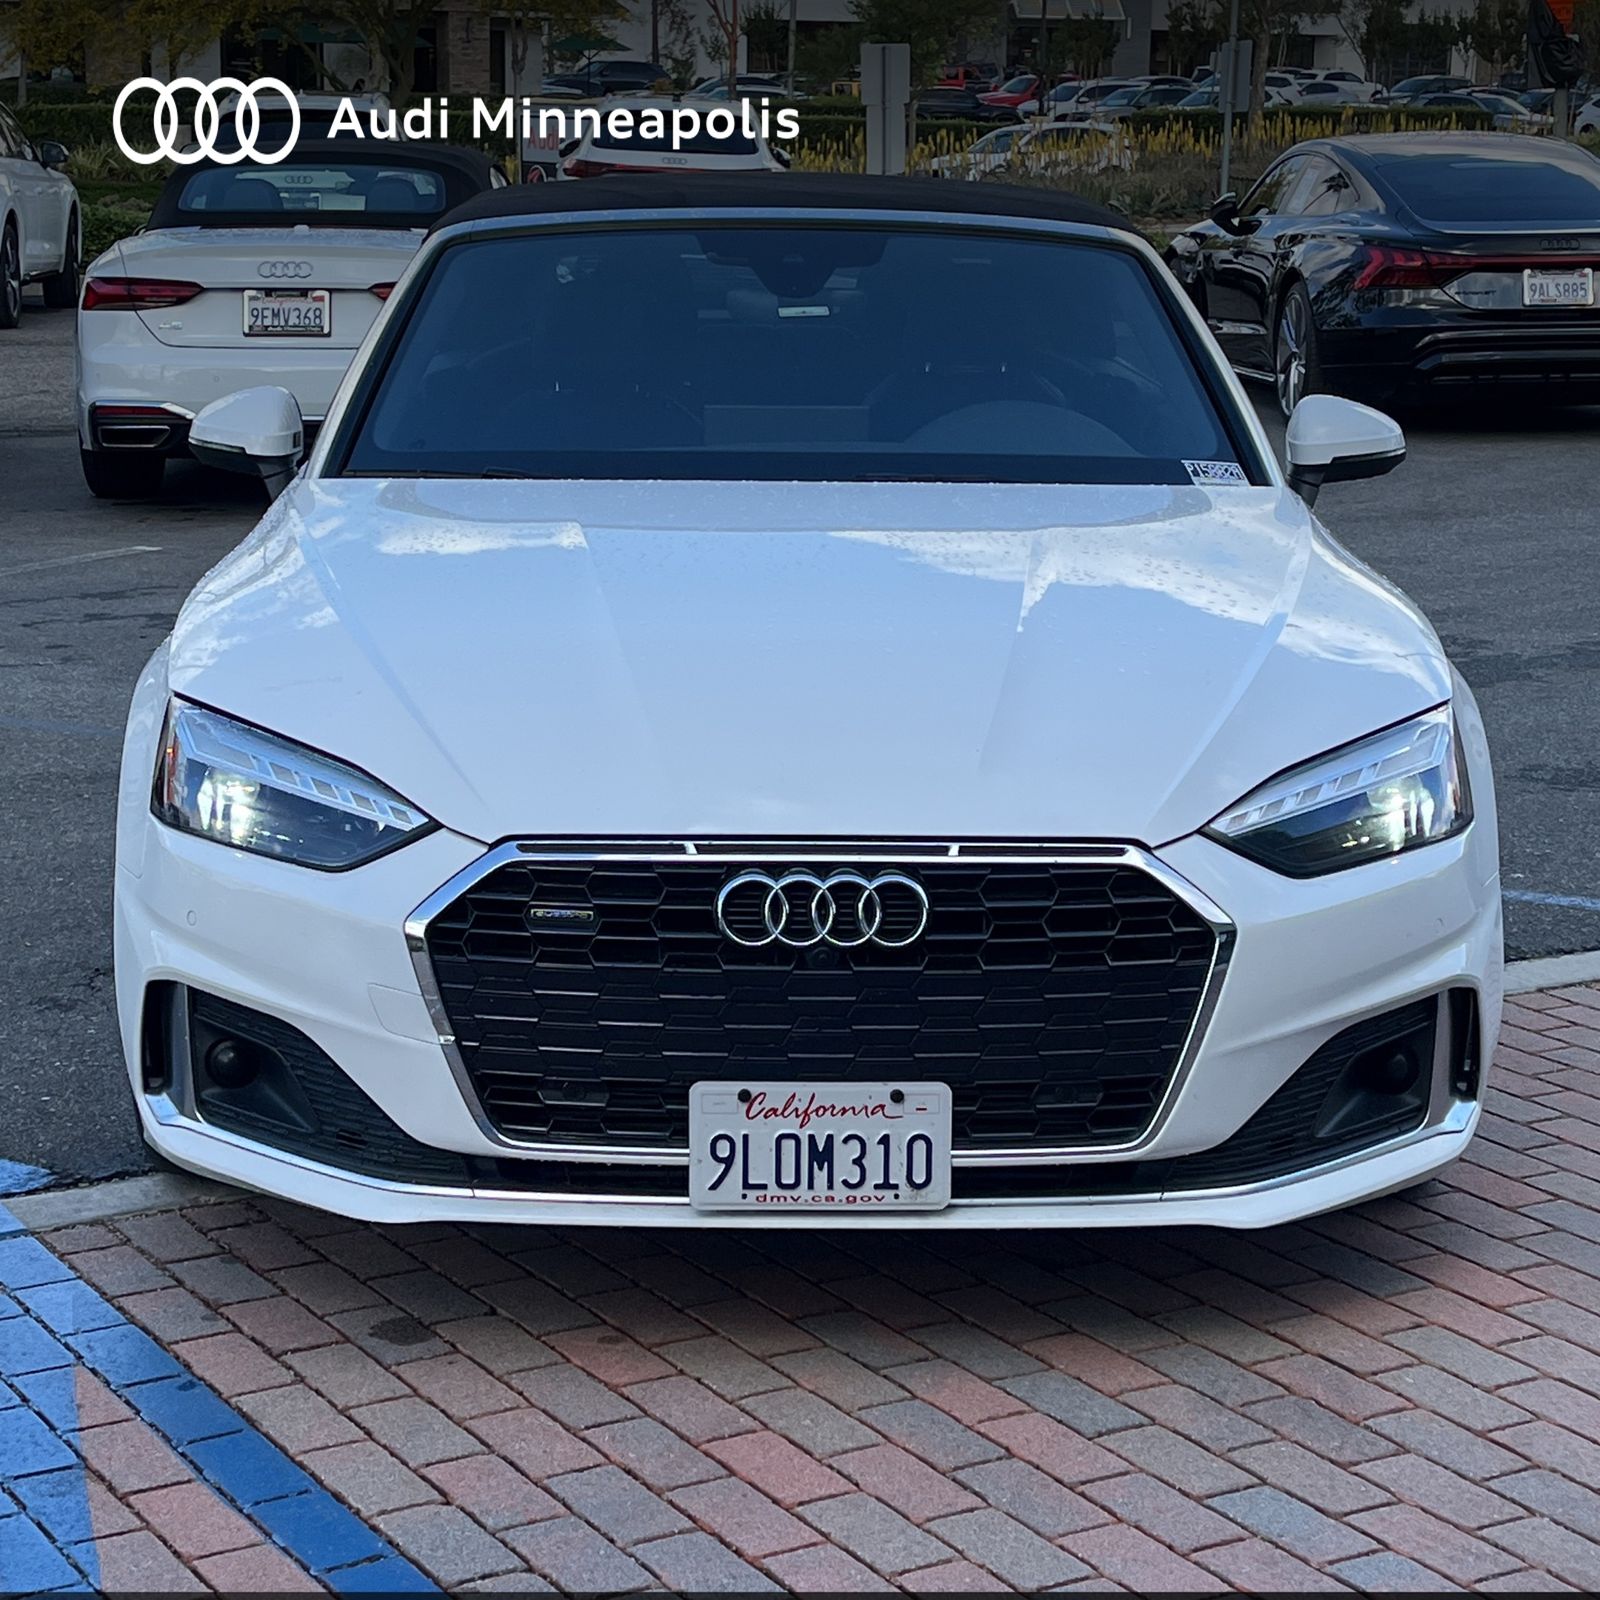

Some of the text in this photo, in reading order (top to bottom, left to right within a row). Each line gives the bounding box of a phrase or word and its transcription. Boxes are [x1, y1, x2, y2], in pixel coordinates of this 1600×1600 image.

[1529, 282, 1587, 299] 9ALS885
[745, 1091, 904, 1129] California
[707, 1132, 933, 1191] 9LOM310
[755, 1193, 886, 1204] dmv.ca.gov
